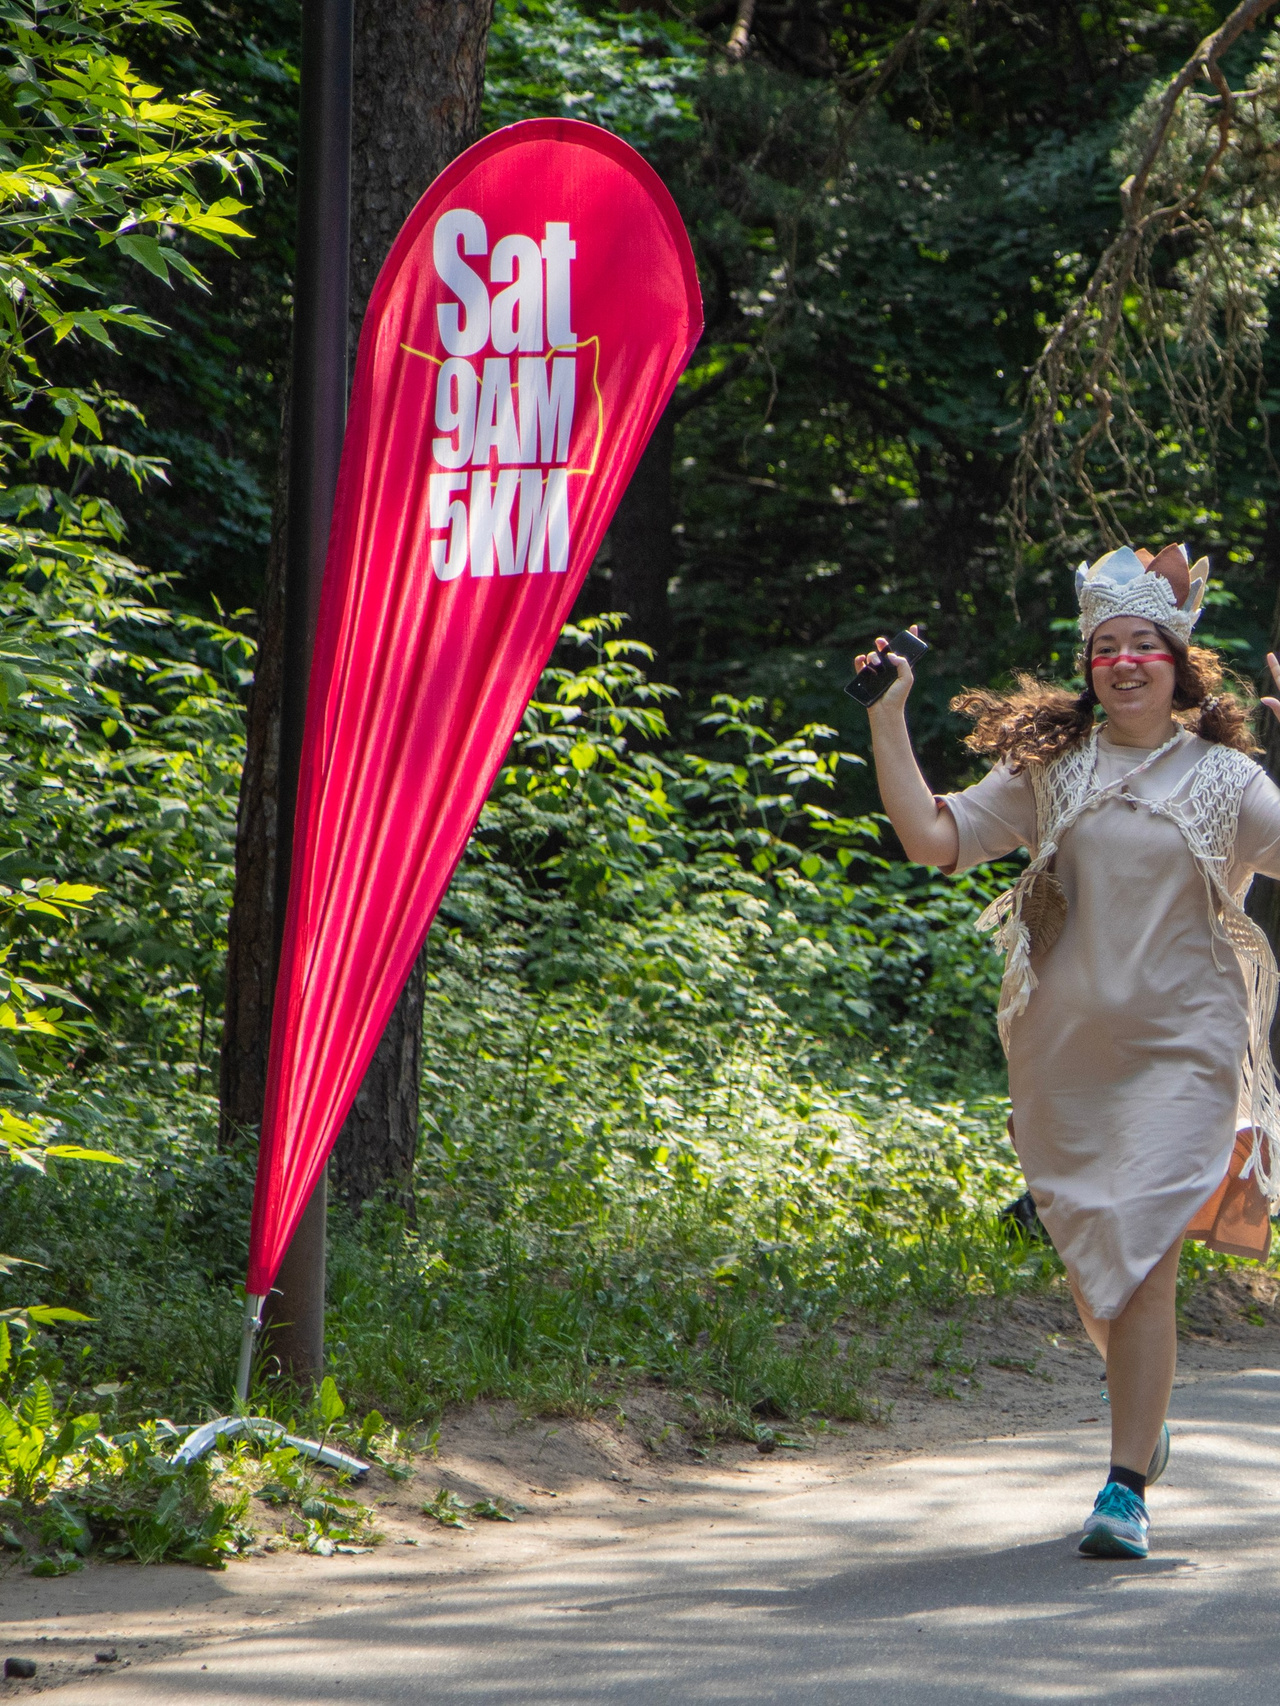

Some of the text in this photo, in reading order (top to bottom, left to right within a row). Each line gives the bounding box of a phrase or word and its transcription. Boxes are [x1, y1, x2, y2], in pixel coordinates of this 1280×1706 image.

[433, 209, 577, 356] Sat
[432, 357, 576, 469] 9AM
[429, 468, 570, 581] 5KM
